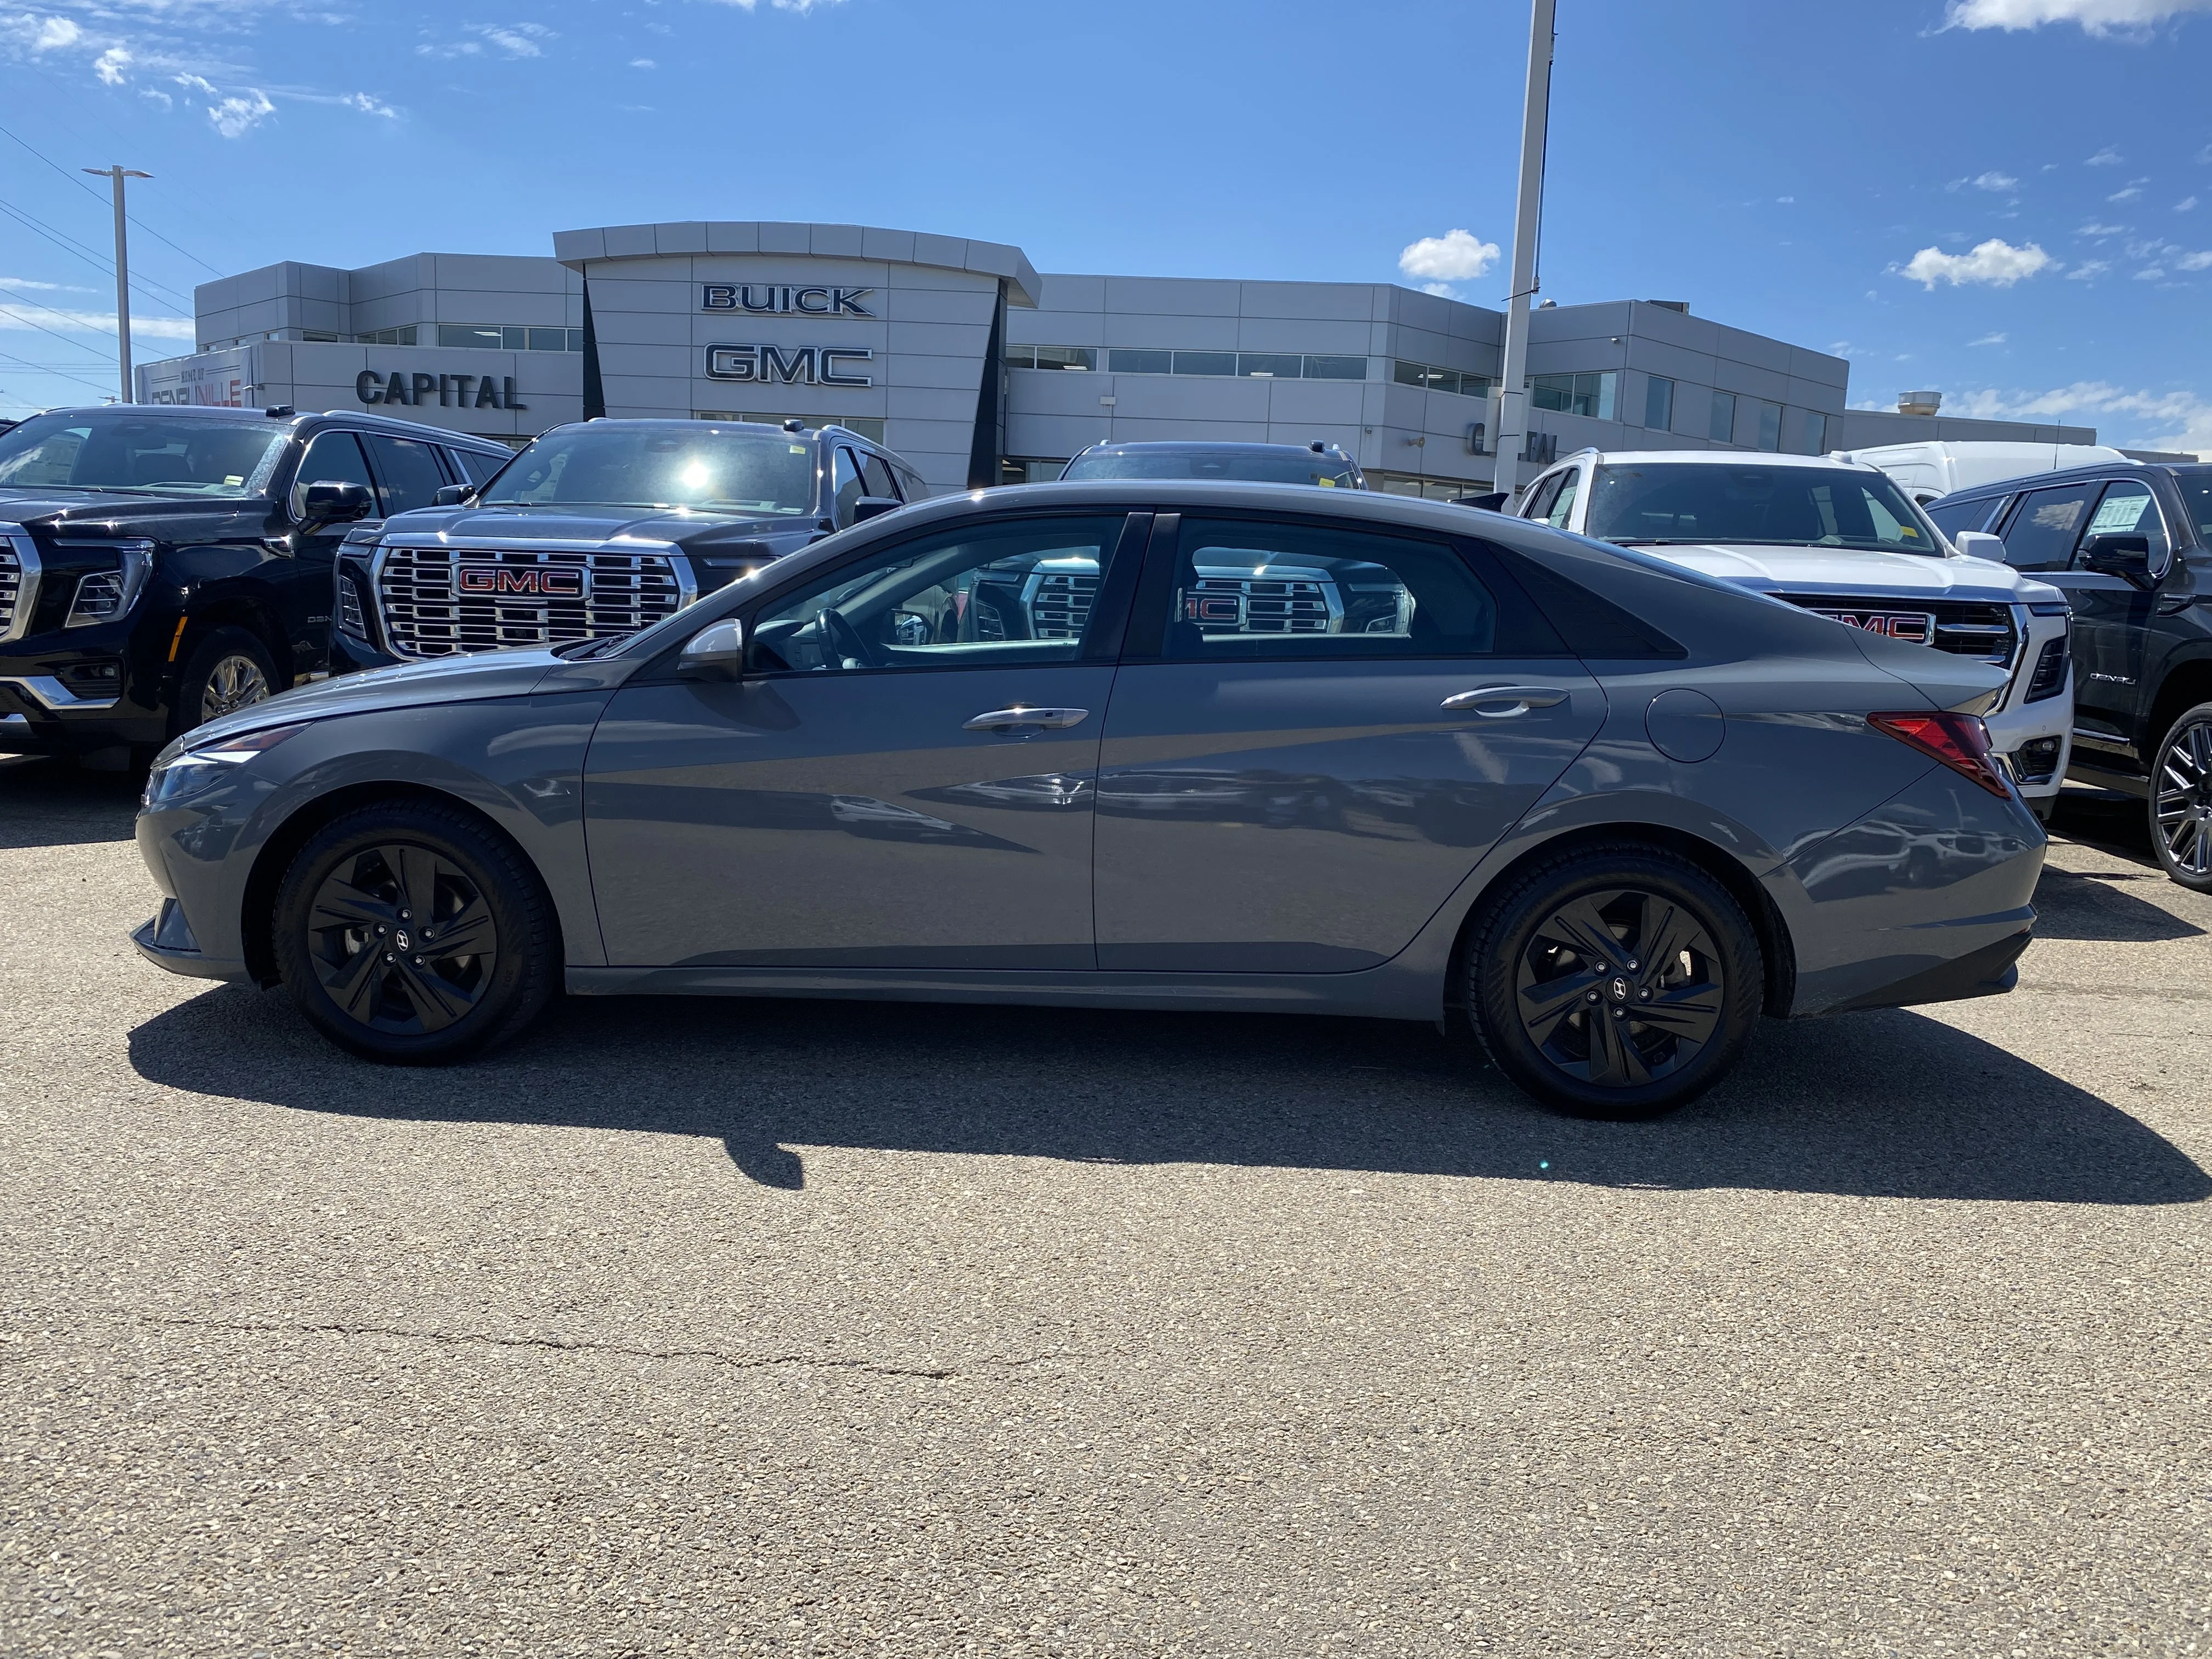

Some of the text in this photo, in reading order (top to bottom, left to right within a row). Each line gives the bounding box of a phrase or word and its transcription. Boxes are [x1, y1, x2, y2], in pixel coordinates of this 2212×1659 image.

[701, 283, 876, 317] BUICK
[703, 342, 873, 387] GMC
[357, 370, 527, 410] CAPITAL
[460, 568, 580, 595] GMC
[1822, 614, 1926, 640] MC
